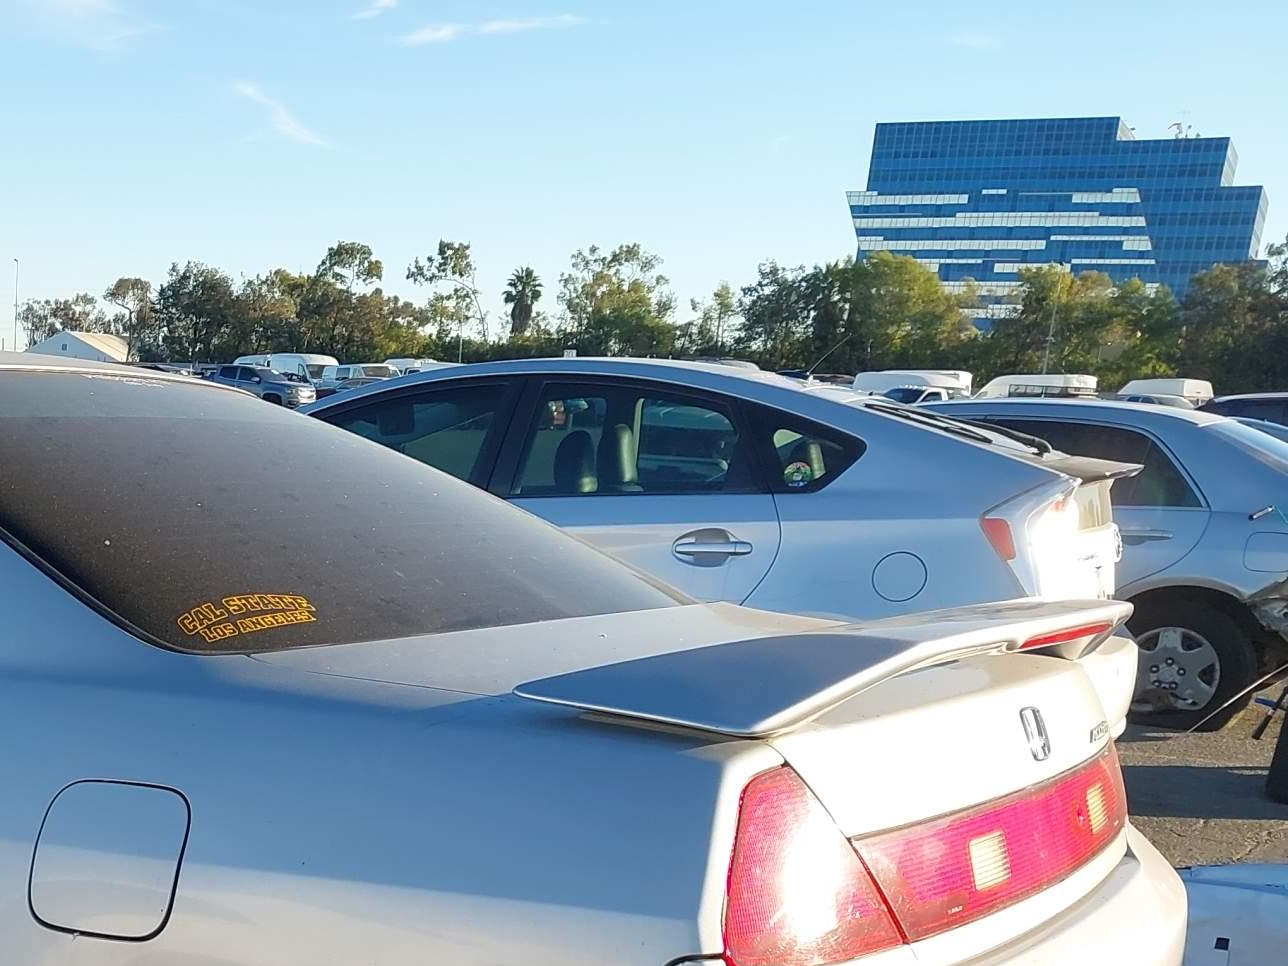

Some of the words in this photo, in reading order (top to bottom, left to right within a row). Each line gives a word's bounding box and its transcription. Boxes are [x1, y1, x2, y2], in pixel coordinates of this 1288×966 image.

[177, 602, 229, 635] CAL
[222, 593, 316, 615] STATE
[200, 622, 239, 643] LOS
[237, 609, 317, 633] ANGELES
